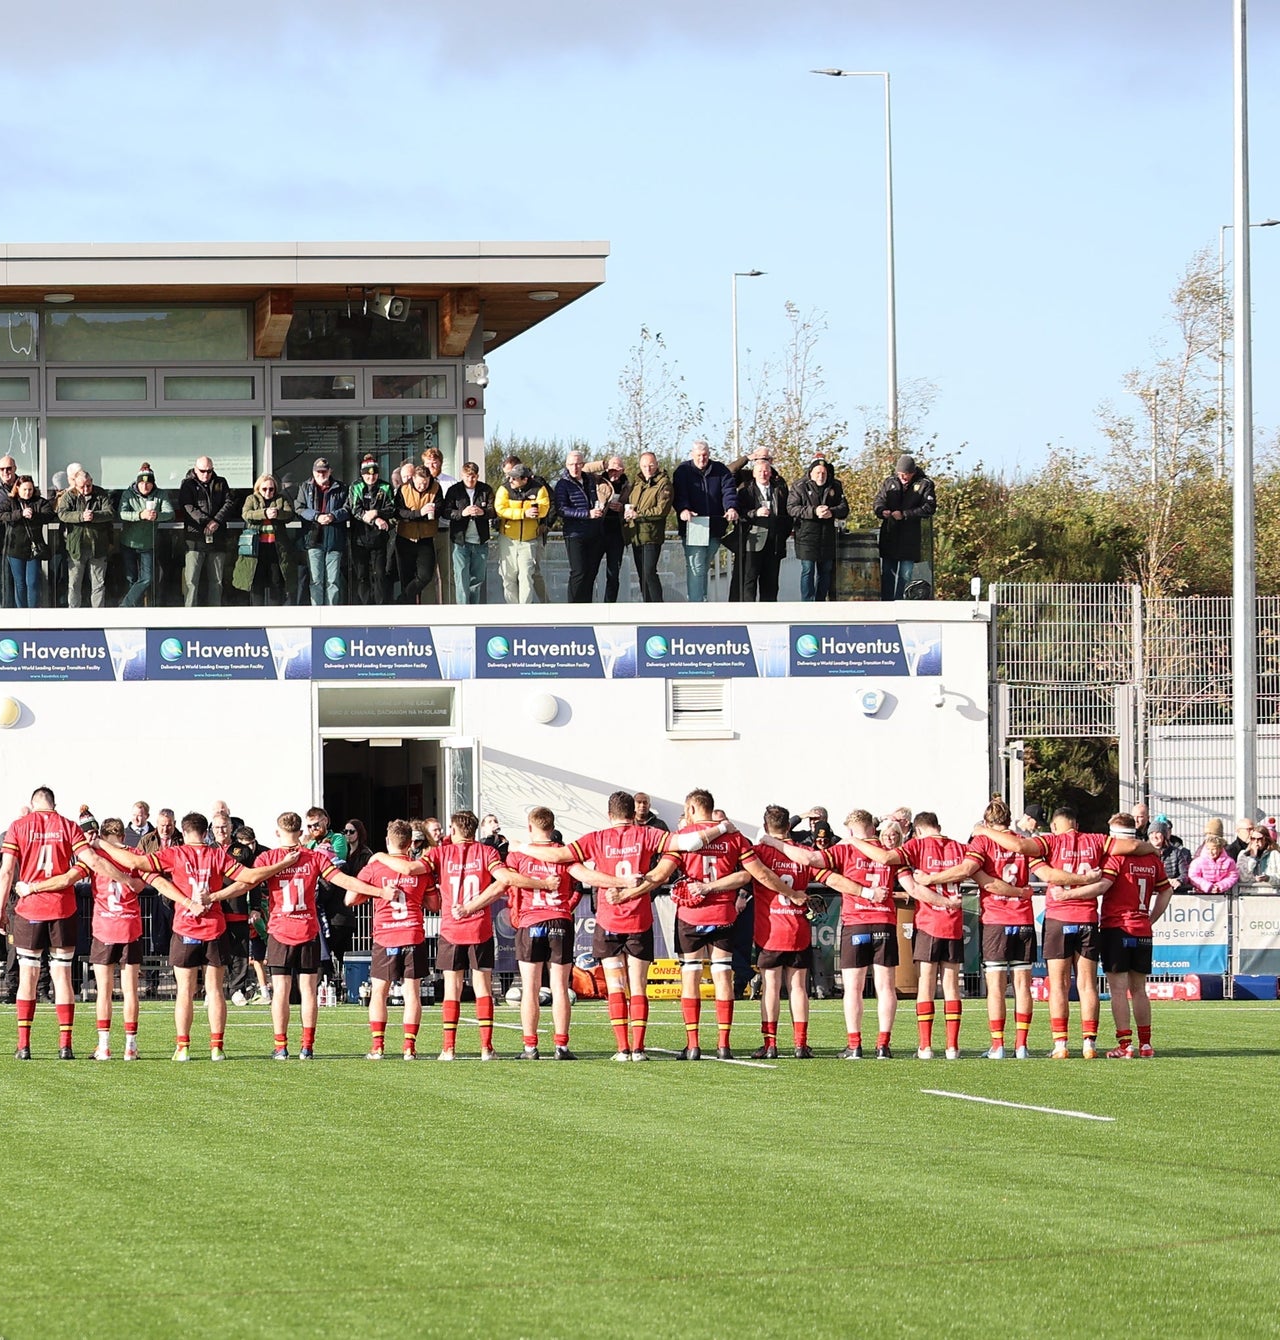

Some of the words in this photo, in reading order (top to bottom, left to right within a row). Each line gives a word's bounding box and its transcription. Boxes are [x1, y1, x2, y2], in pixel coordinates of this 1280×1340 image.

[23, 642, 106, 659] Haventus
[187, 641, 269, 658] Haventus
[350, 640, 432, 656] Haventus
[513, 640, 595, 656] Haventus
[671, 639, 750, 655] Haventus
[822, 638, 900, 654] Haventus
[37, 845, 53, 877] 4
[279, 878, 307, 912] 11
[1137, 879, 1146, 910] 1
[1173, 929, 1215, 941] Services
